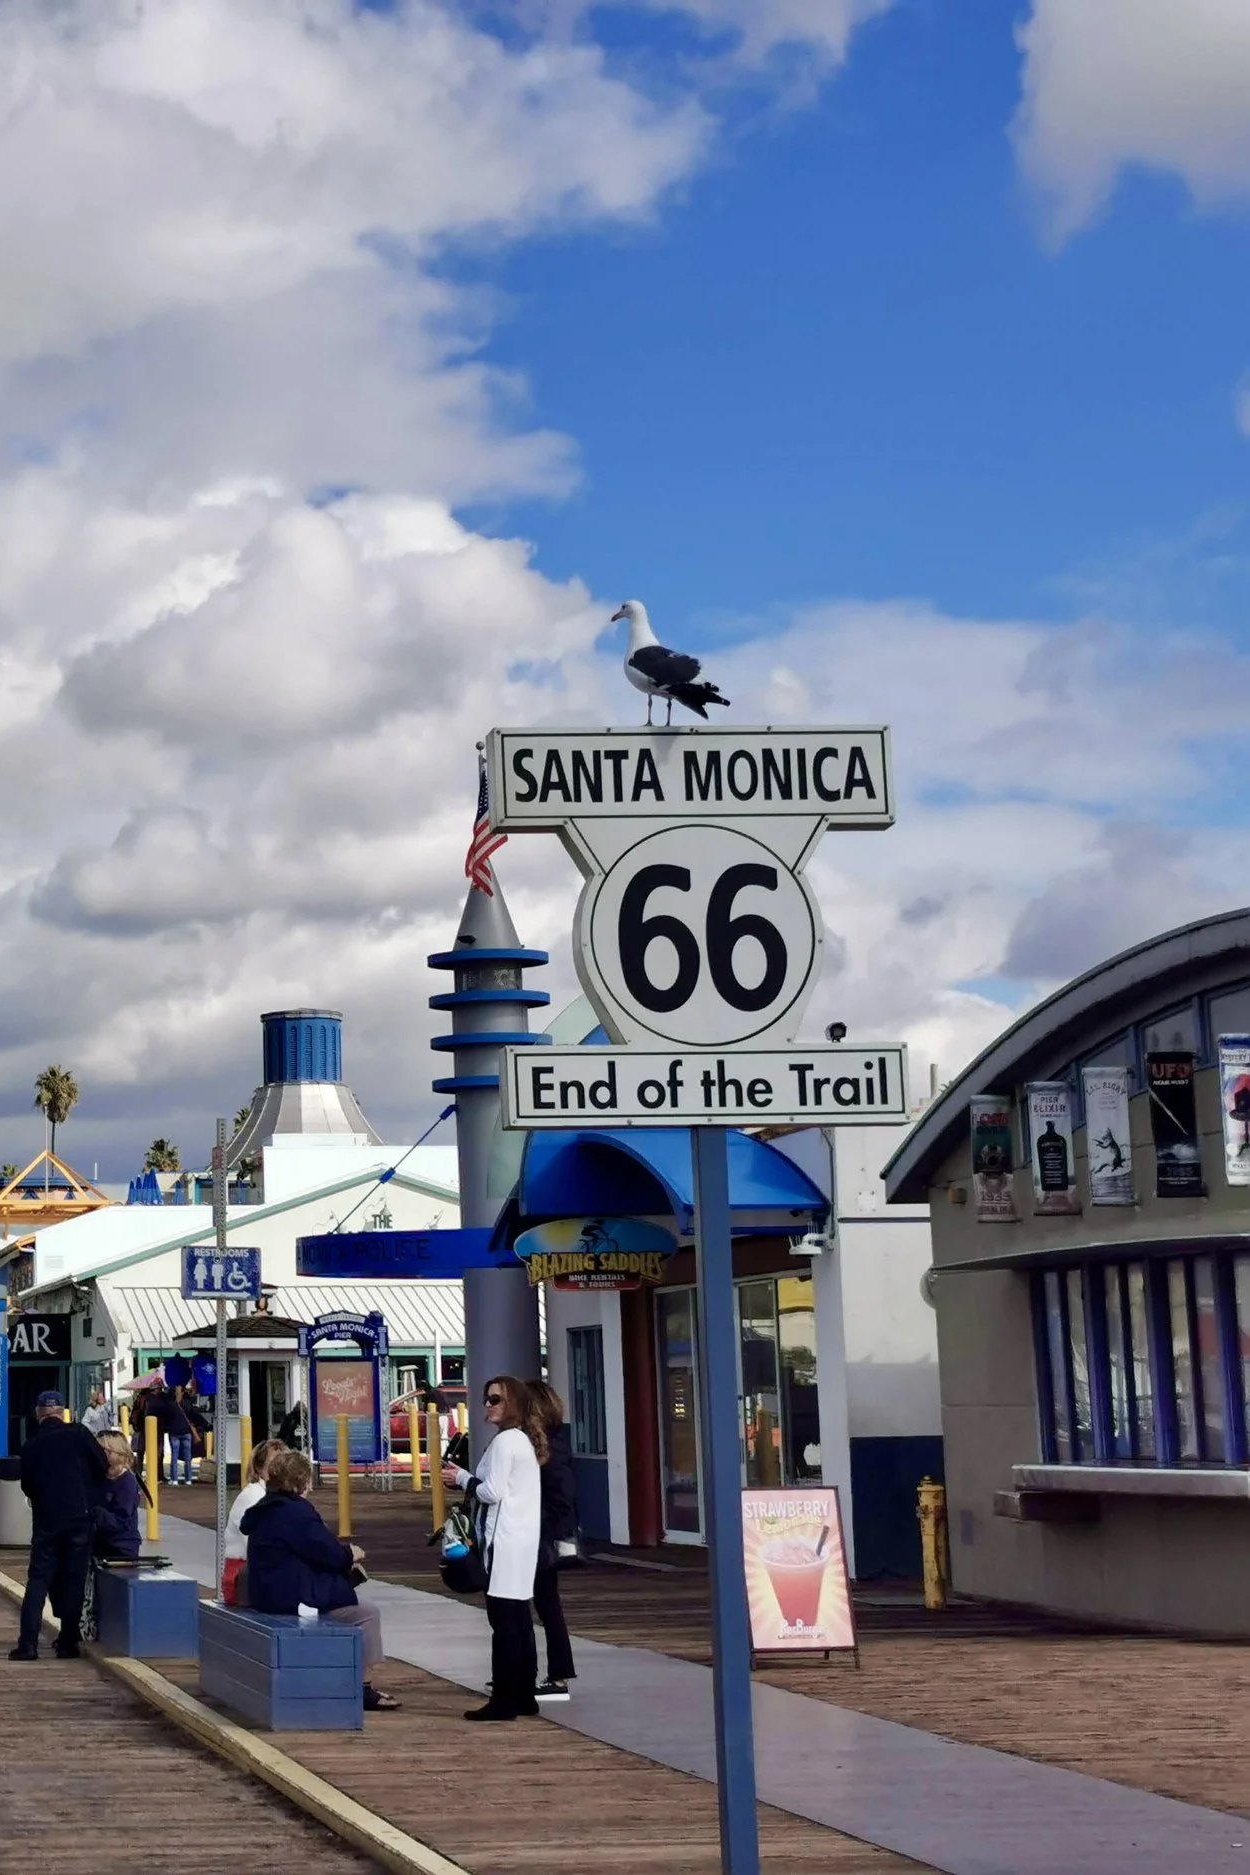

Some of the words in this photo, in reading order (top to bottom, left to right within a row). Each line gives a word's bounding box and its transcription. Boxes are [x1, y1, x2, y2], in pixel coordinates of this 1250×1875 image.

[512, 747, 665, 803] SANTA
[683, 746, 876, 802] MONICA
[618, 863, 788, 1013] 66
[1152, 1063, 1191, 1078] UFO
[531, 1060, 617, 1110] End
[636, 1059, 683, 1109] of
[700, 1059, 773, 1108] the
[789, 1057, 889, 1107] Trail
[1033, 1104, 1066, 1112] ELIXIR
[372, 1214, 393, 1228] THE
[194, 1248, 250, 1258] RESTROOMS
[352, 1238, 432, 1261] POLICE
[530, 1253, 596, 1284] BLAZING
[599, 1251, 664, 1281] SADDLES
[590, 1273, 626, 1281] RENTALS
[7, 1323, 58, 1355] AR
[311, 1323, 338, 1339] SANTA
[340, 1322, 375, 1338] MONICA
[744, 1500, 829, 1518] STRAWBERRY
